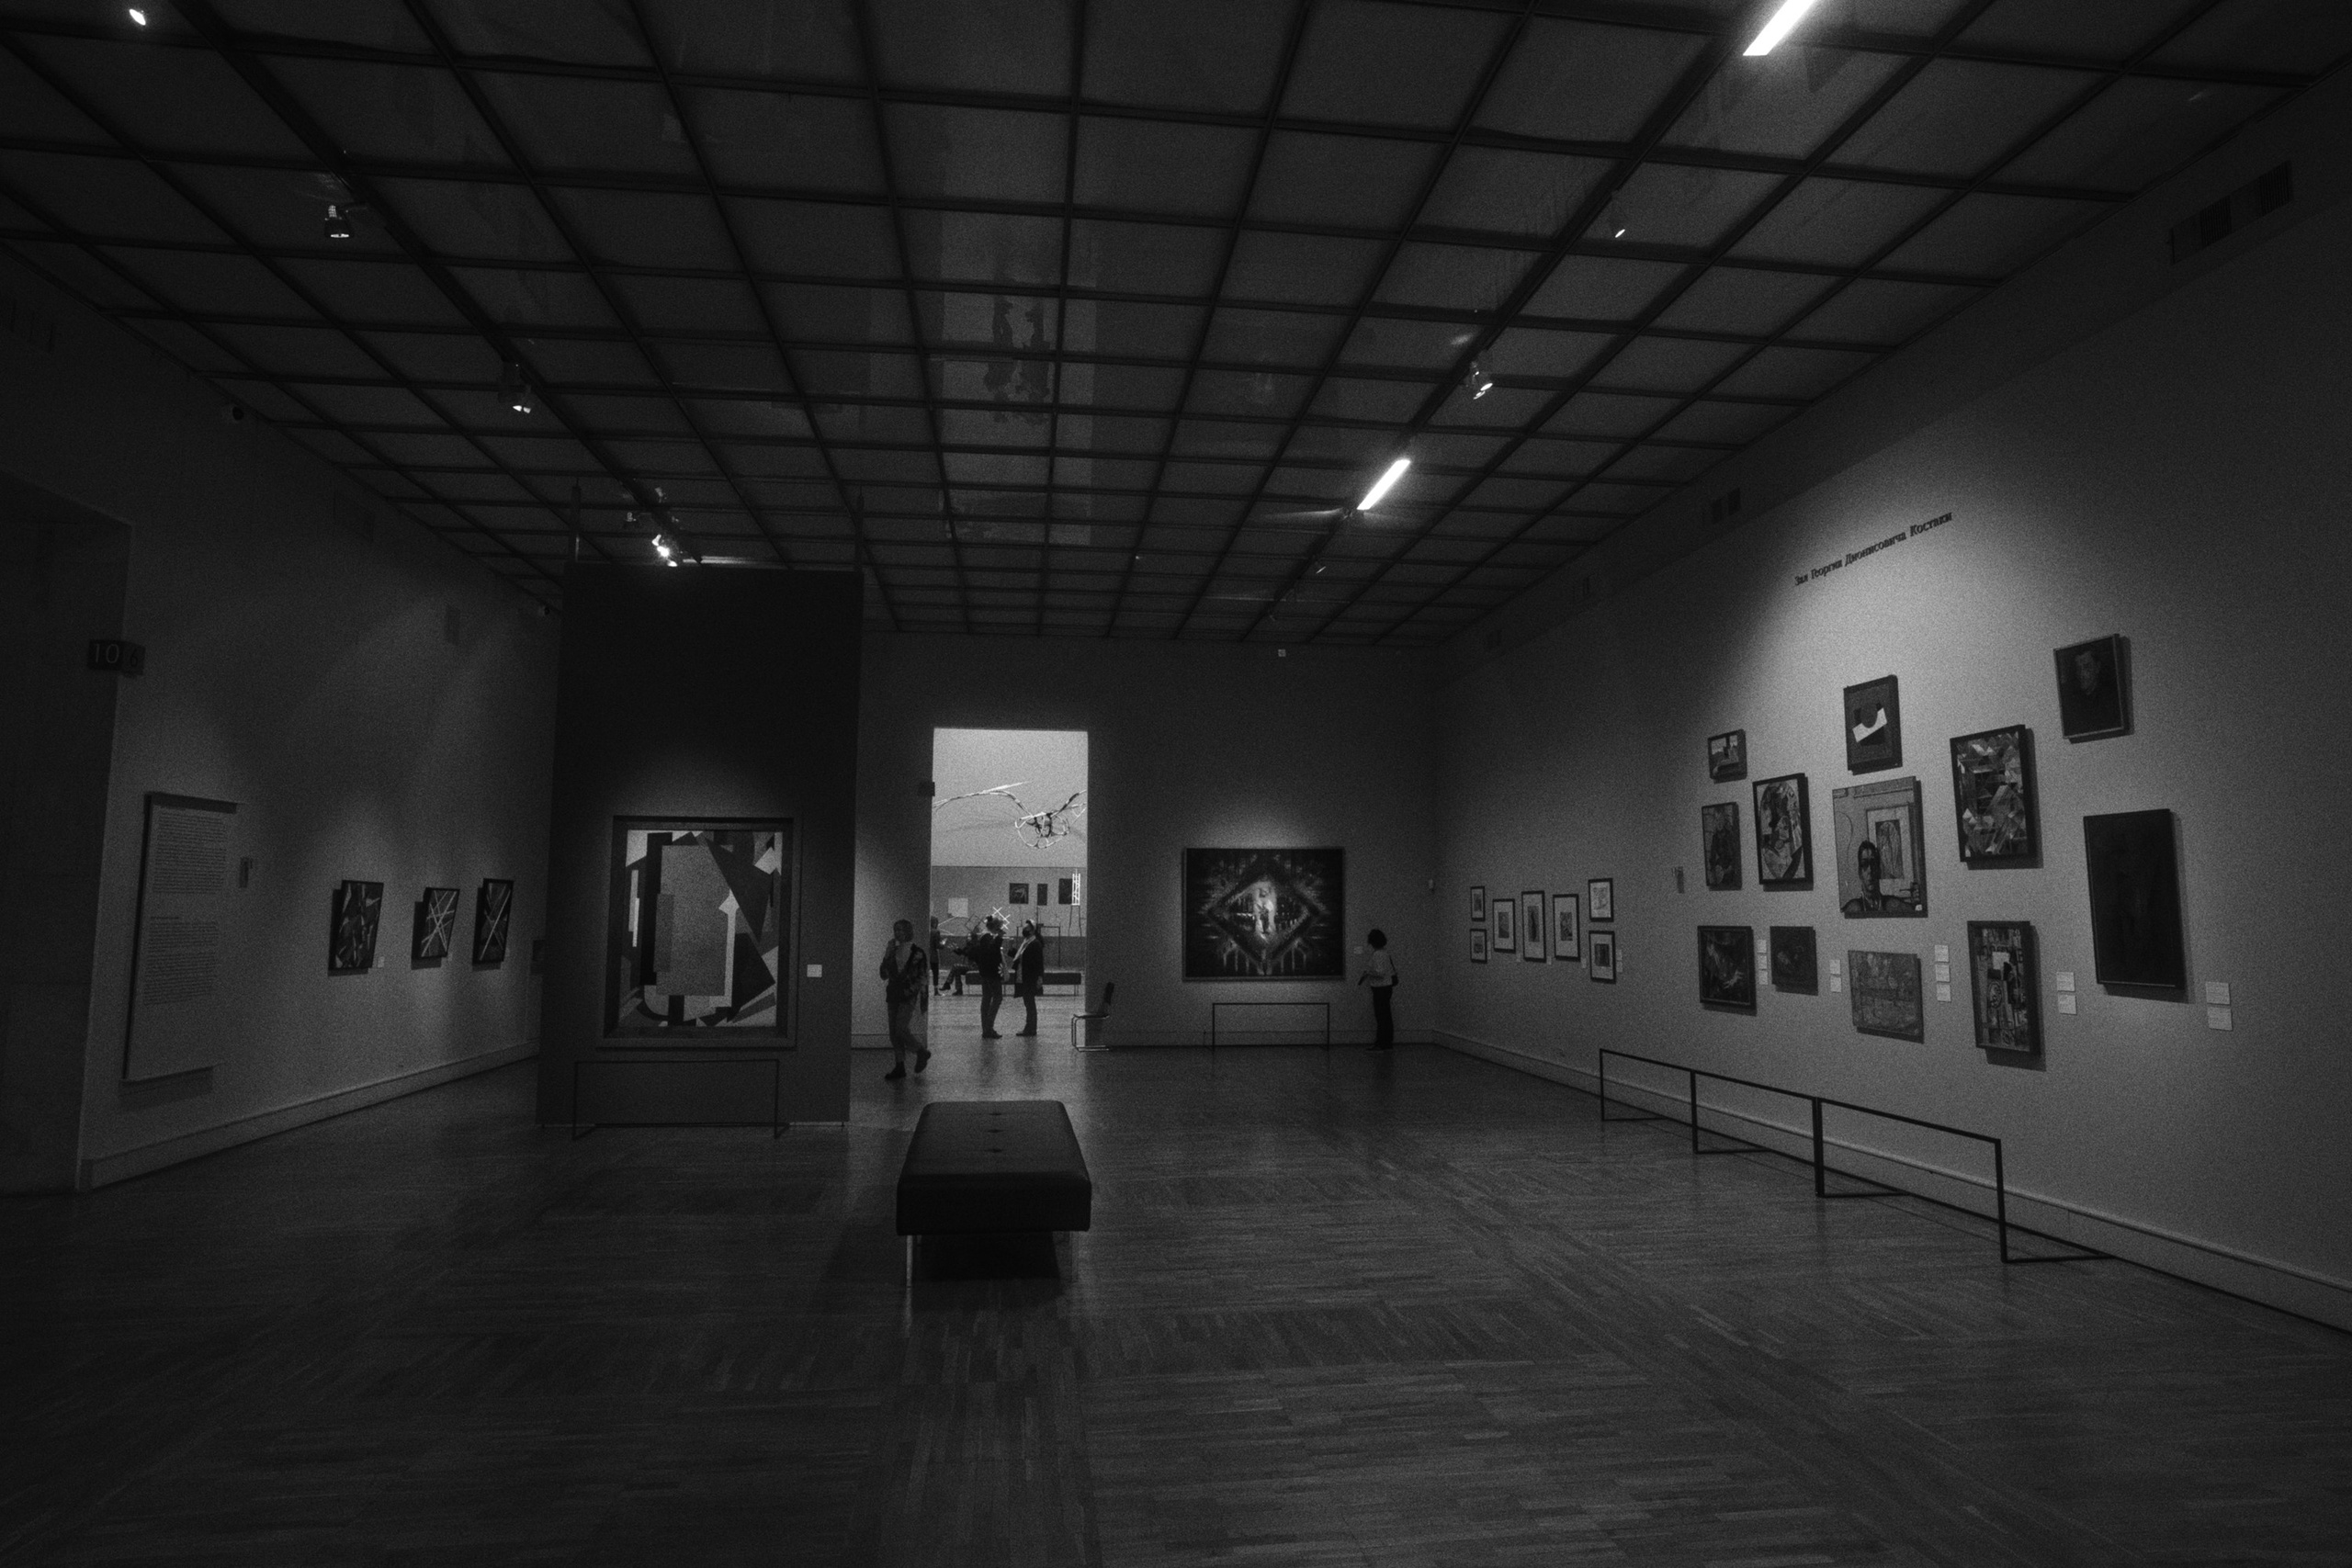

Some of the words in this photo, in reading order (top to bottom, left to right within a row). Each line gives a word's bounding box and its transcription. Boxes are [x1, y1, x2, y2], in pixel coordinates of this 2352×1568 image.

[1811, 558, 1843, 580] Георгия
[1845, 532, 1906, 567] Дионисовича
[1910, 512, 1953, 537] Костаки
[94, 643, 120, 664] 10
